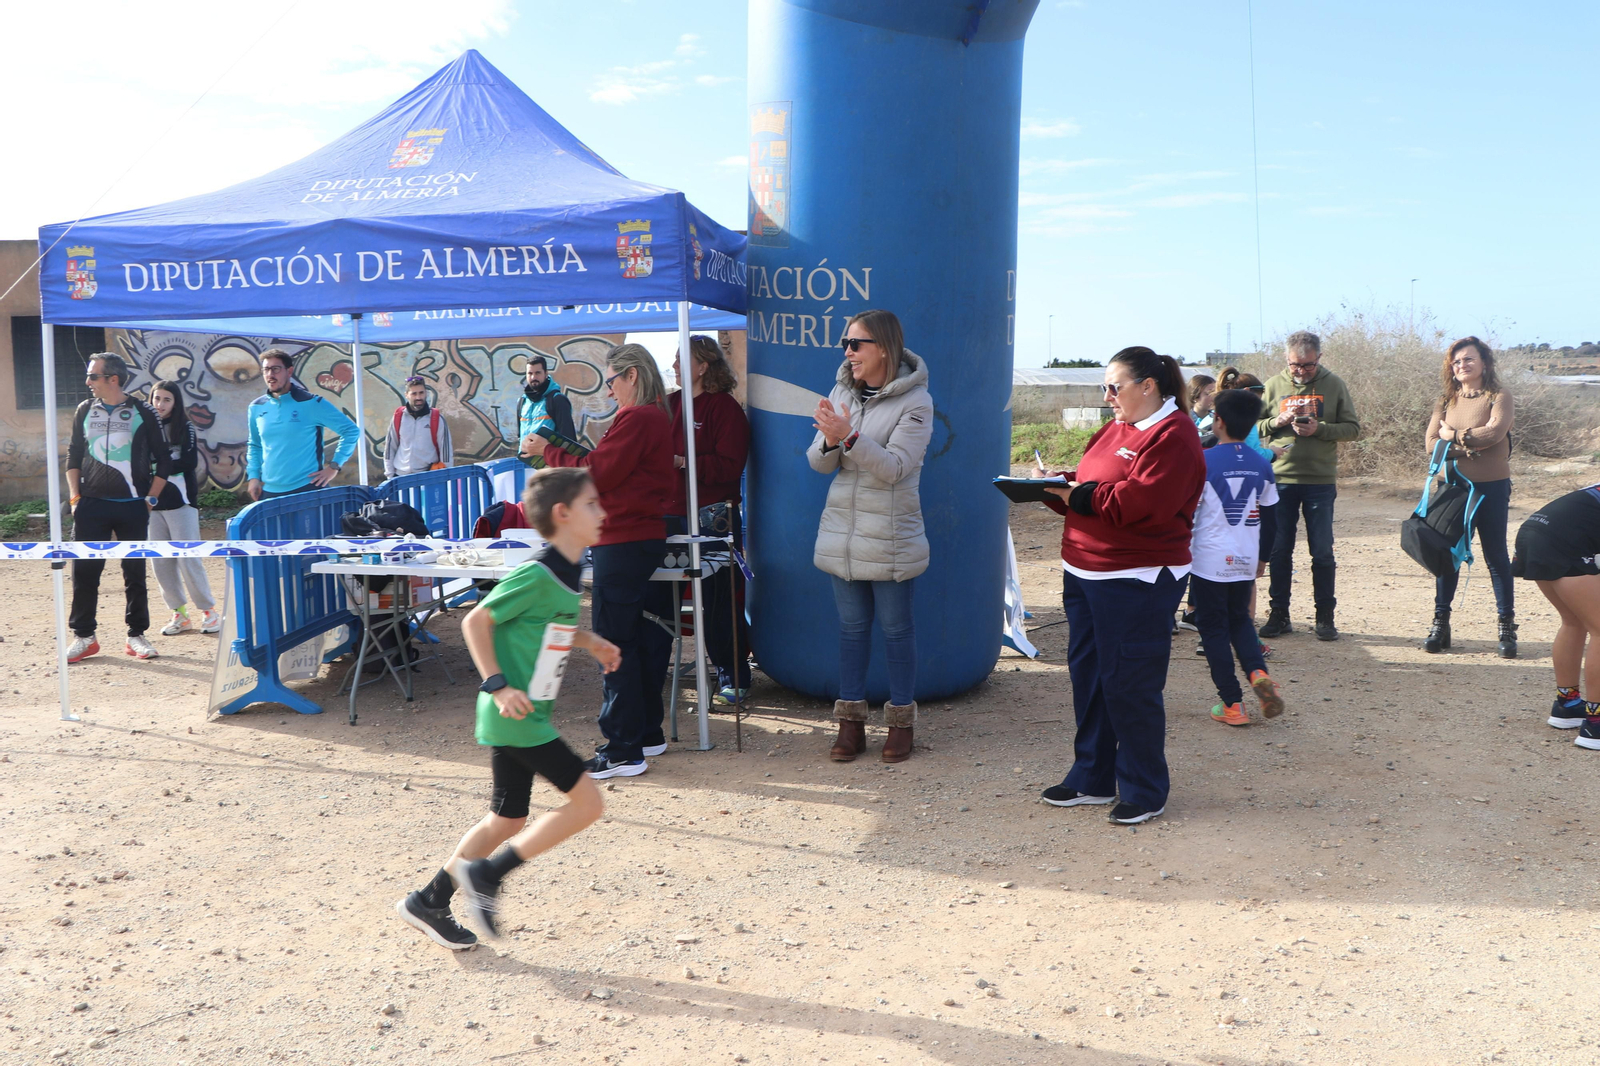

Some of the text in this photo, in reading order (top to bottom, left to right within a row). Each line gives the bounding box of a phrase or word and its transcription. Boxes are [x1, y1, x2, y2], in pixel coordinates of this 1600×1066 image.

[300, 184, 460, 203] DE ALMERÍA
[310, 170, 479, 191] DIPUTACIÓN
[122, 237, 588, 293] DIPUTACIÓN DE ALMERÍA
[746, 257, 873, 301] TACIÓN
[746, 305, 853, 349] LMERÍ
